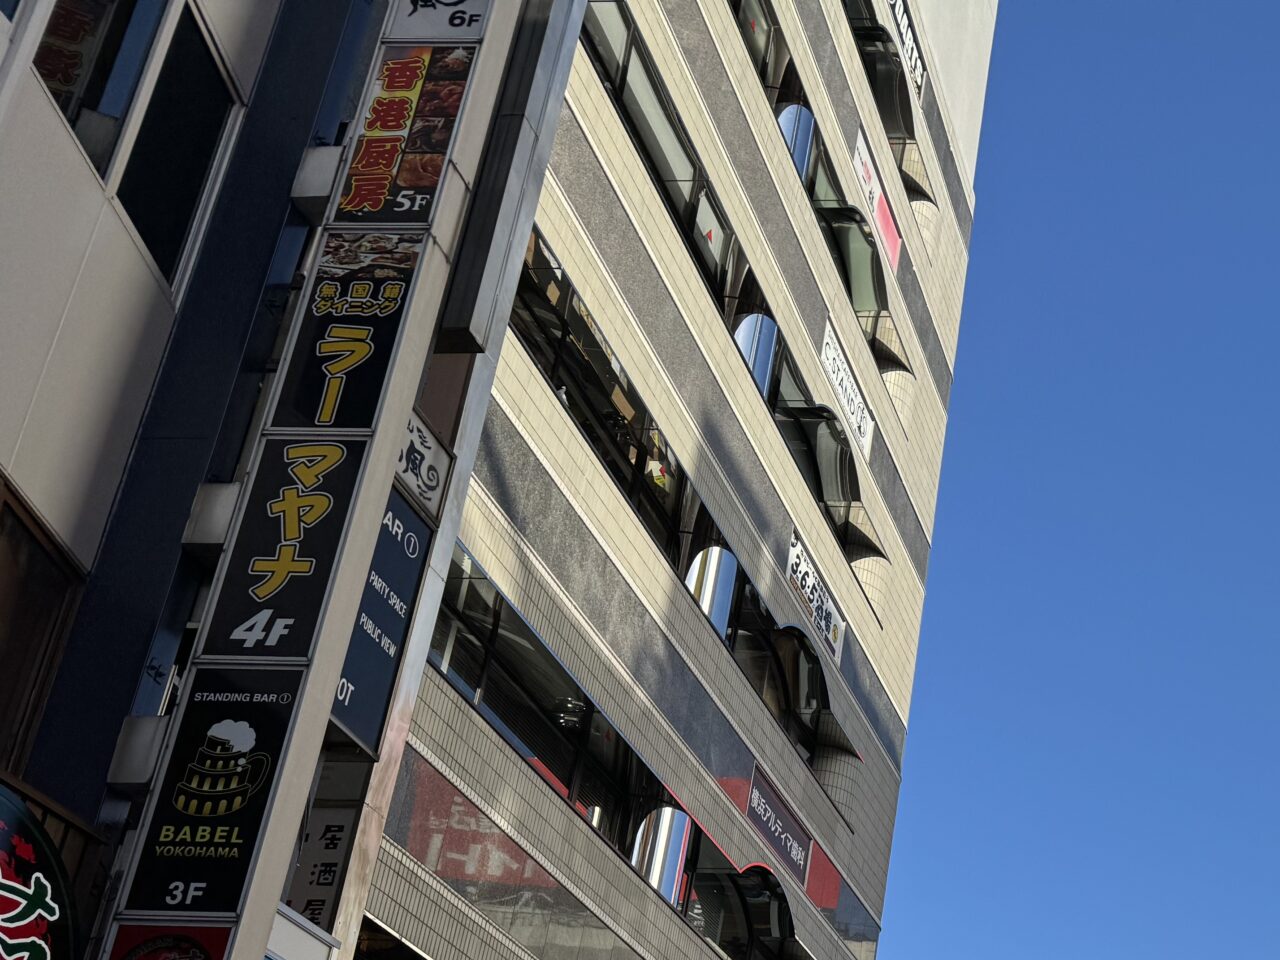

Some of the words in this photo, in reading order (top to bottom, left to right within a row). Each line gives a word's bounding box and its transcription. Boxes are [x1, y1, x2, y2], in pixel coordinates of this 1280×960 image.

[449, 11, 482, 27] 6F
[339, 55, 426, 213] 香港厨房
[393, 190, 430, 212] 5F
[316, 281, 406, 299] 無国籍
[312, 299, 400, 317] ダイニング
[369, 570, 390, 600] PARTY
[387, 590, 408, 620] SPACE
[229, 609, 296, 648] 4F
[359, 612, 381, 644] PUBLIC
[380, 632, 397, 659] VIEW
[193, 692, 251, 702] STANDING
[253, 692, 278, 703] BAR
[159, 824, 245, 845] BABEL
[749, 784, 807, 871] 横浜アルティマ歯科
[155, 845, 240, 859] YOKOHAMA
[165, 880, 208, 906] 3F
